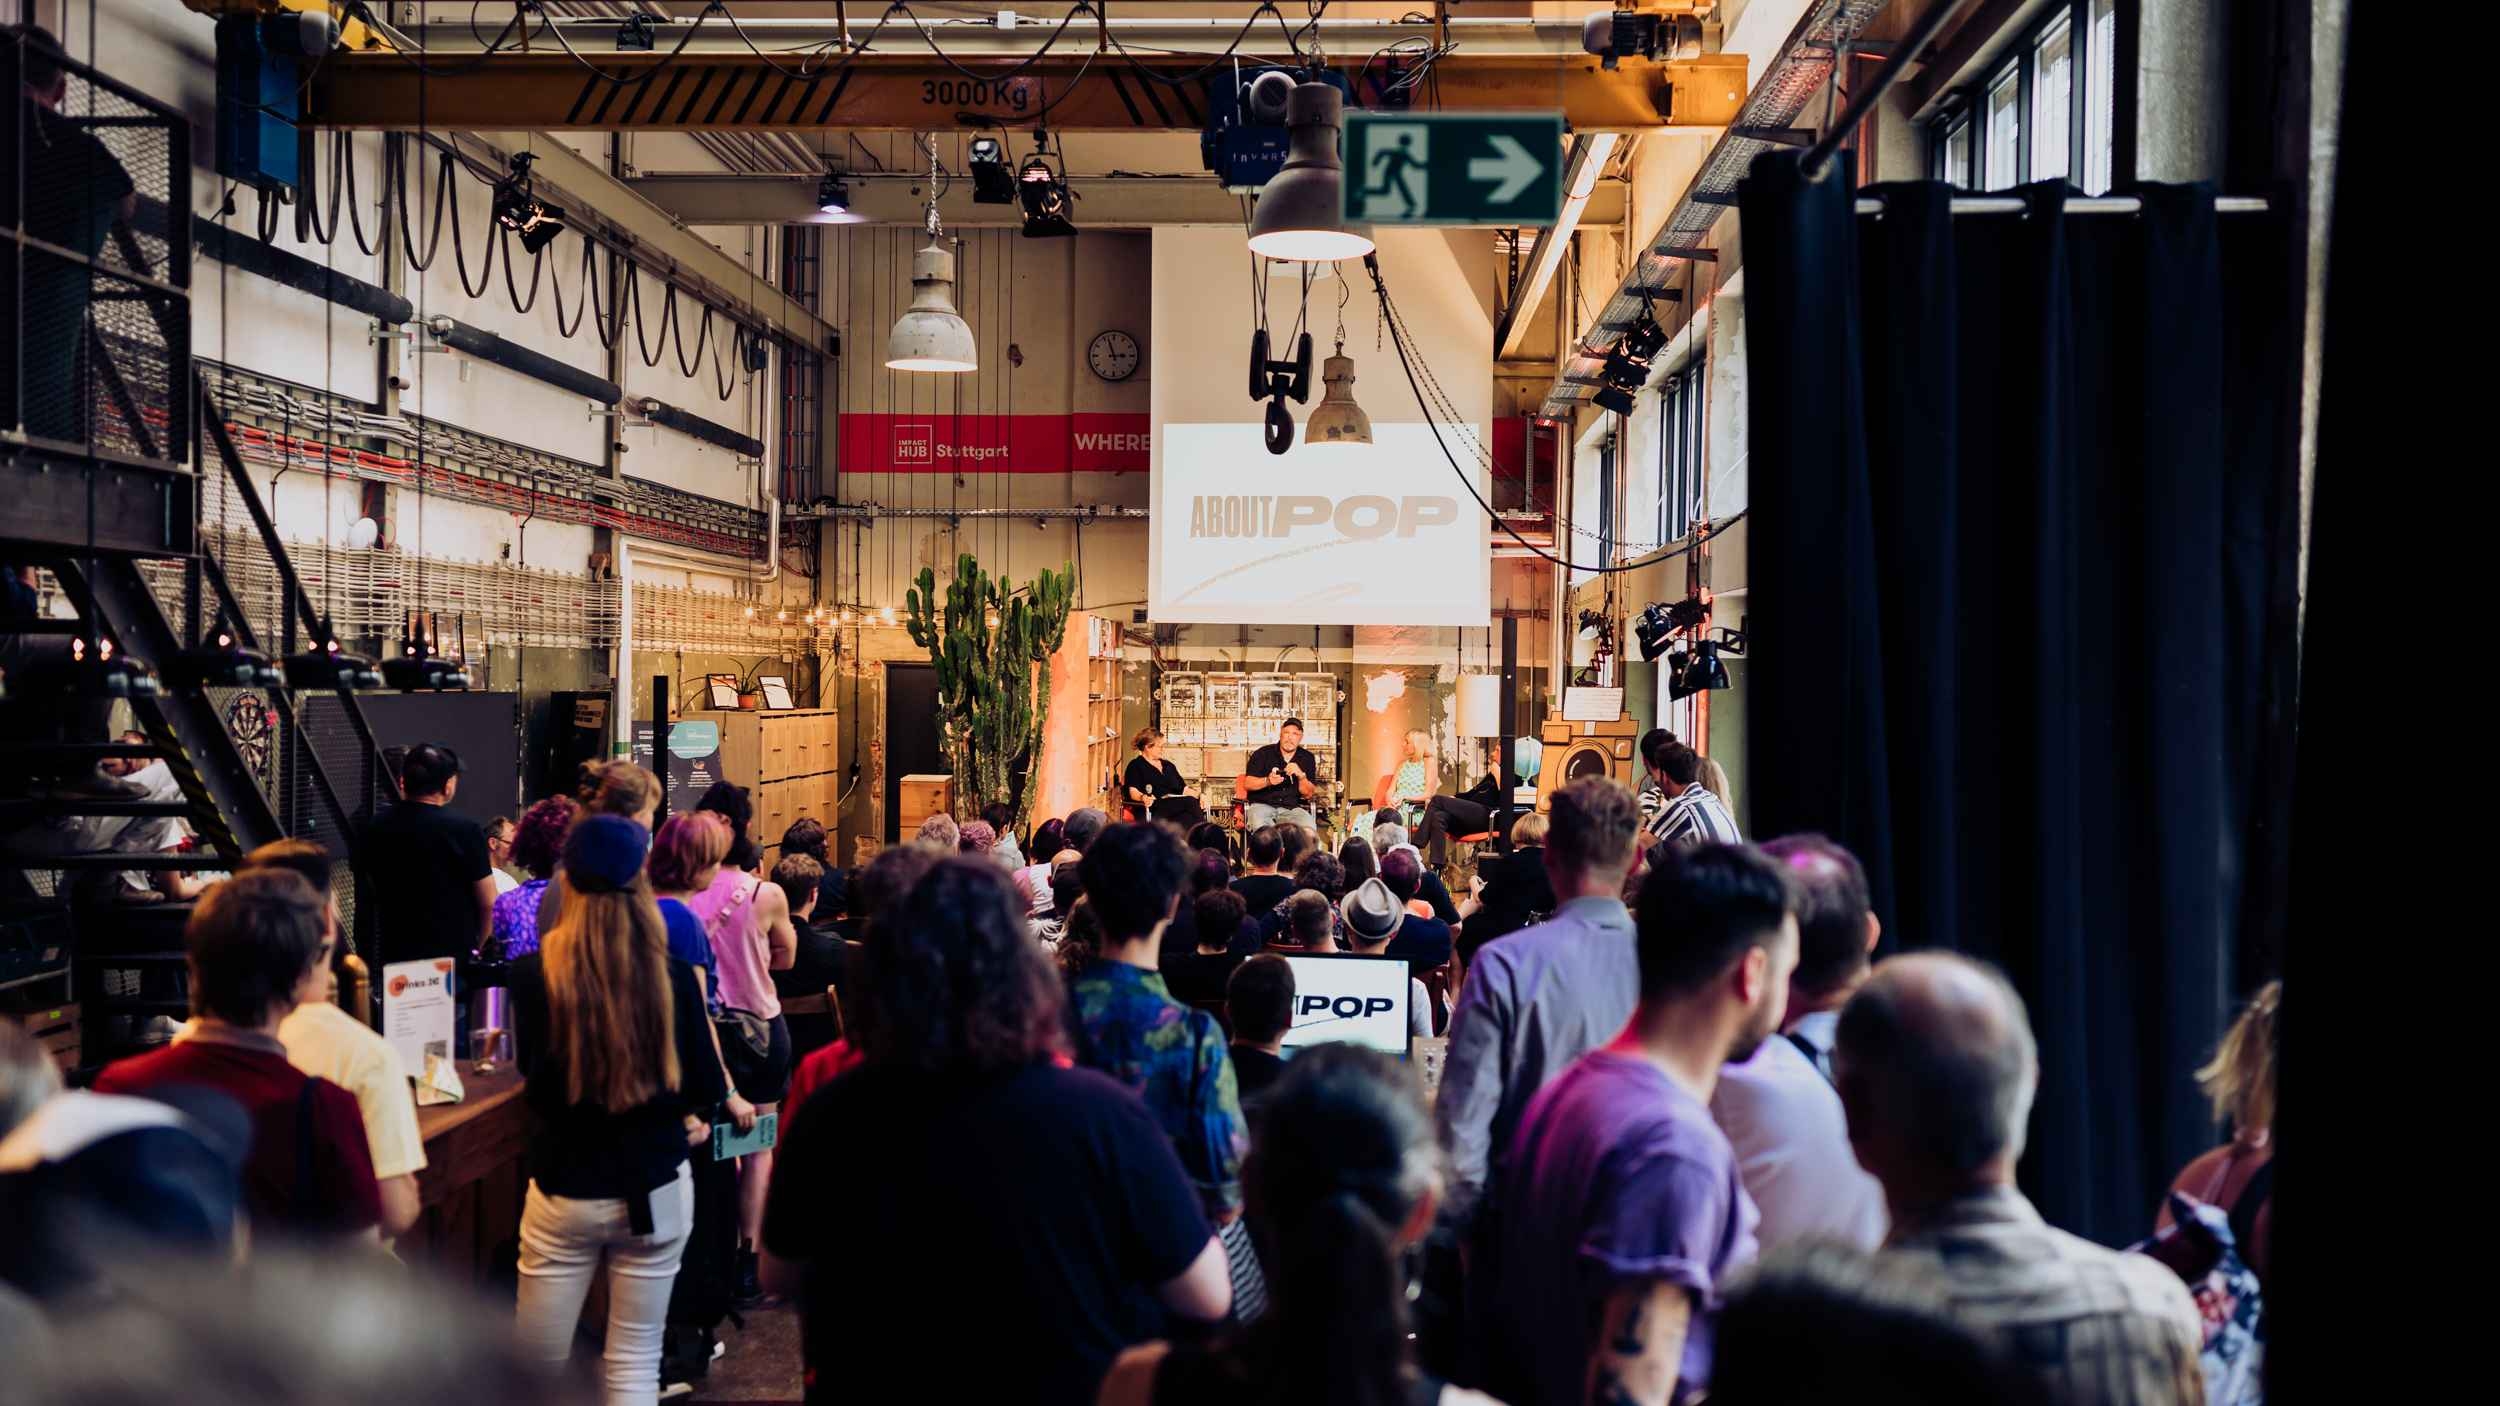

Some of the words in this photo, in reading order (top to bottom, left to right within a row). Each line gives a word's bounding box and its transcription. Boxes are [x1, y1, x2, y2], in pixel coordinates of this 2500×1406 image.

[898, 439, 927, 447] IMPACT
[1074, 433, 1150, 451] WHERE
[898, 447, 928, 458] HUB
[936, 444, 1009, 461] Stuttgart
[1189, 495, 1274, 538] ABOUT
[1271, 494, 1459, 540] POP
[1300, 995, 1394, 1019] POP
